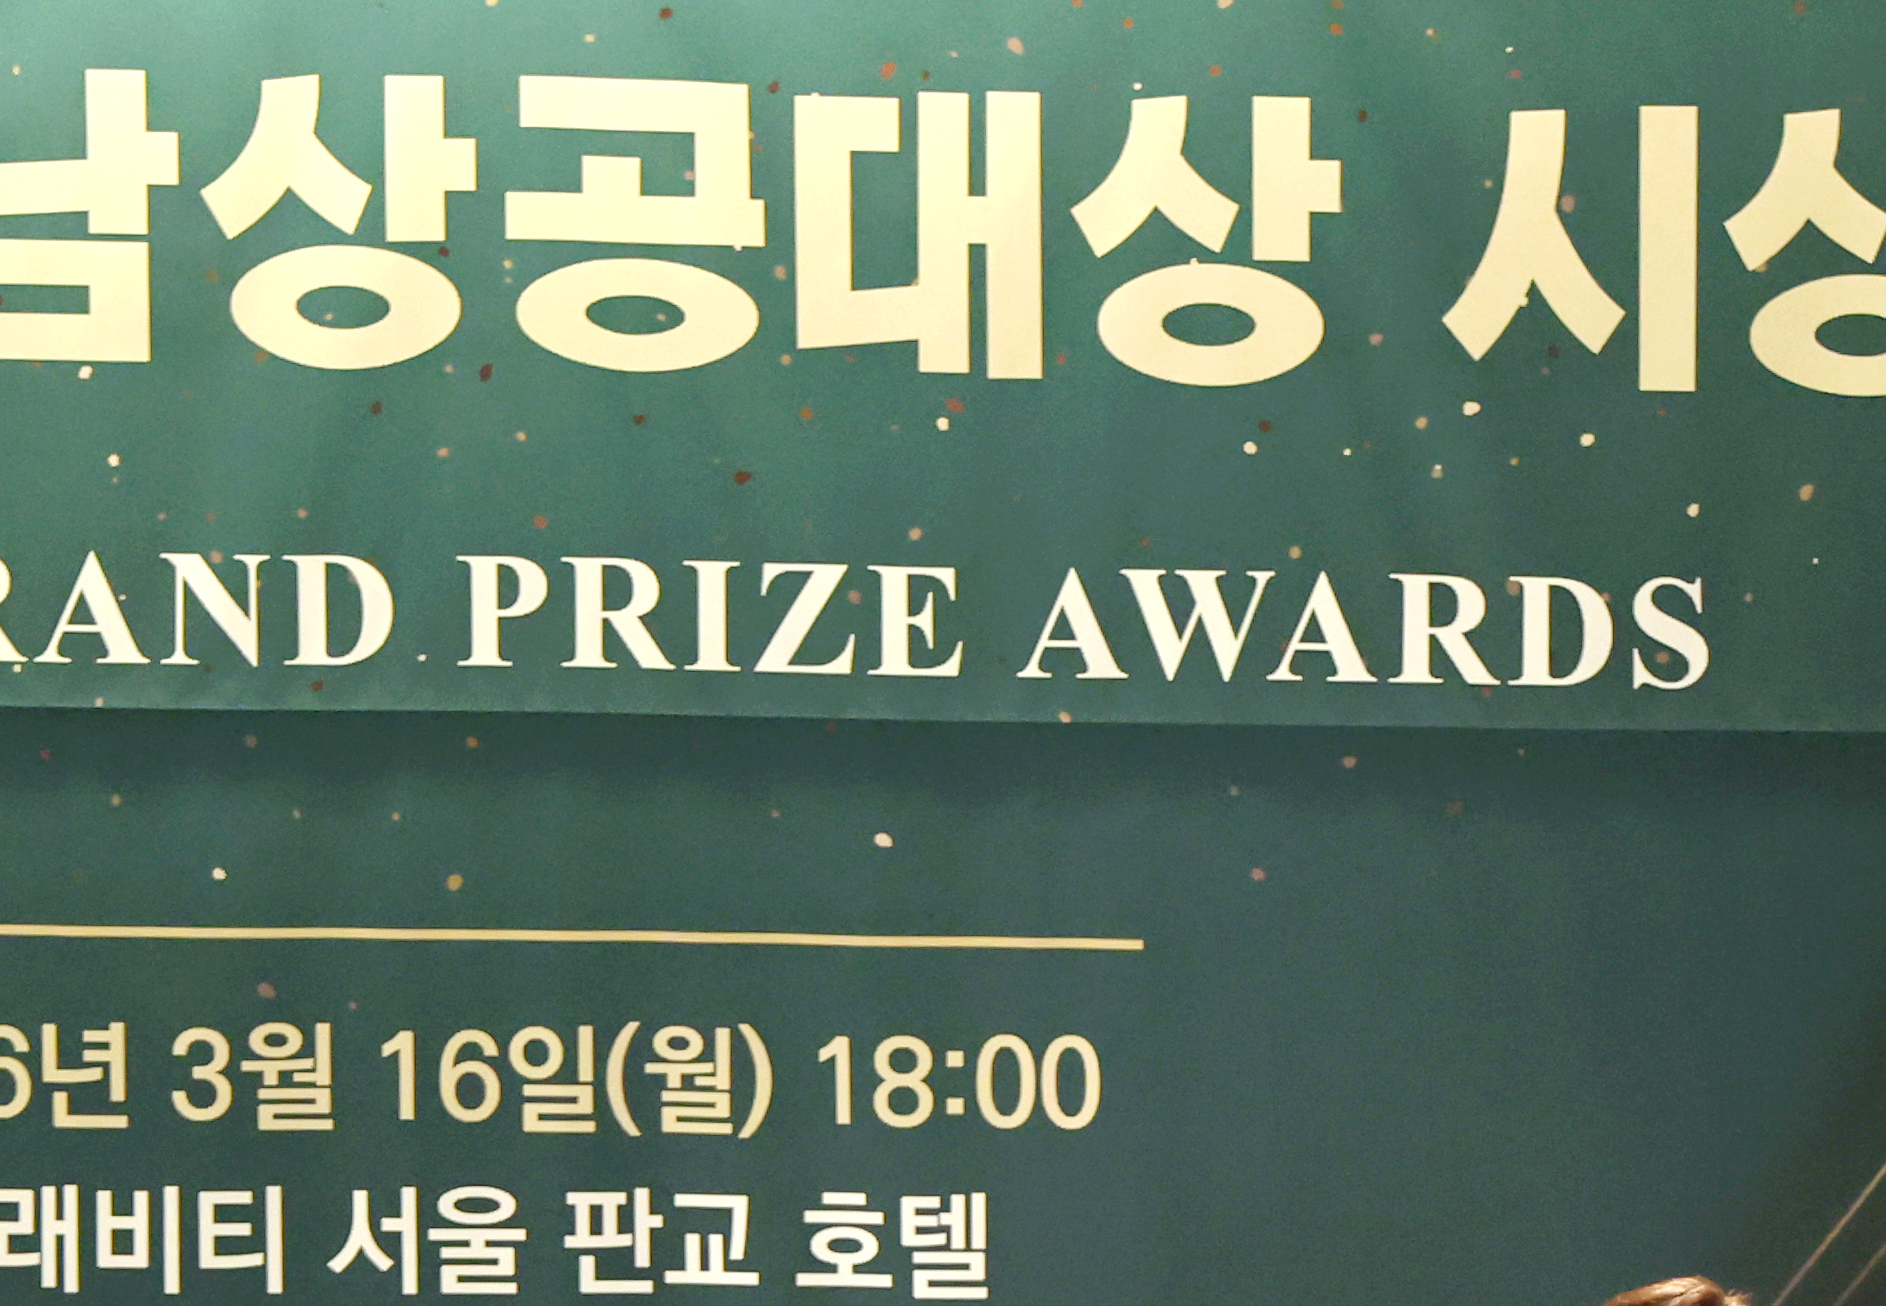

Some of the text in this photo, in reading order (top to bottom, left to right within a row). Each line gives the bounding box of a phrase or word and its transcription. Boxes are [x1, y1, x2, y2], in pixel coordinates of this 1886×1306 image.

[456, 556, 963, 677] PRIZE
[1016, 568, 1709, 689] AWARDS
[172, 1023, 334, 1130] 3월
[382, 1022, 772, 1138] 16일(월)
[819, 1034, 1100, 1129] 18:00
[327, 1186, 526, 1295] 서울
[564, 1188, 759, 1293] 판교
[796, 1192, 988, 1299] 호텔
